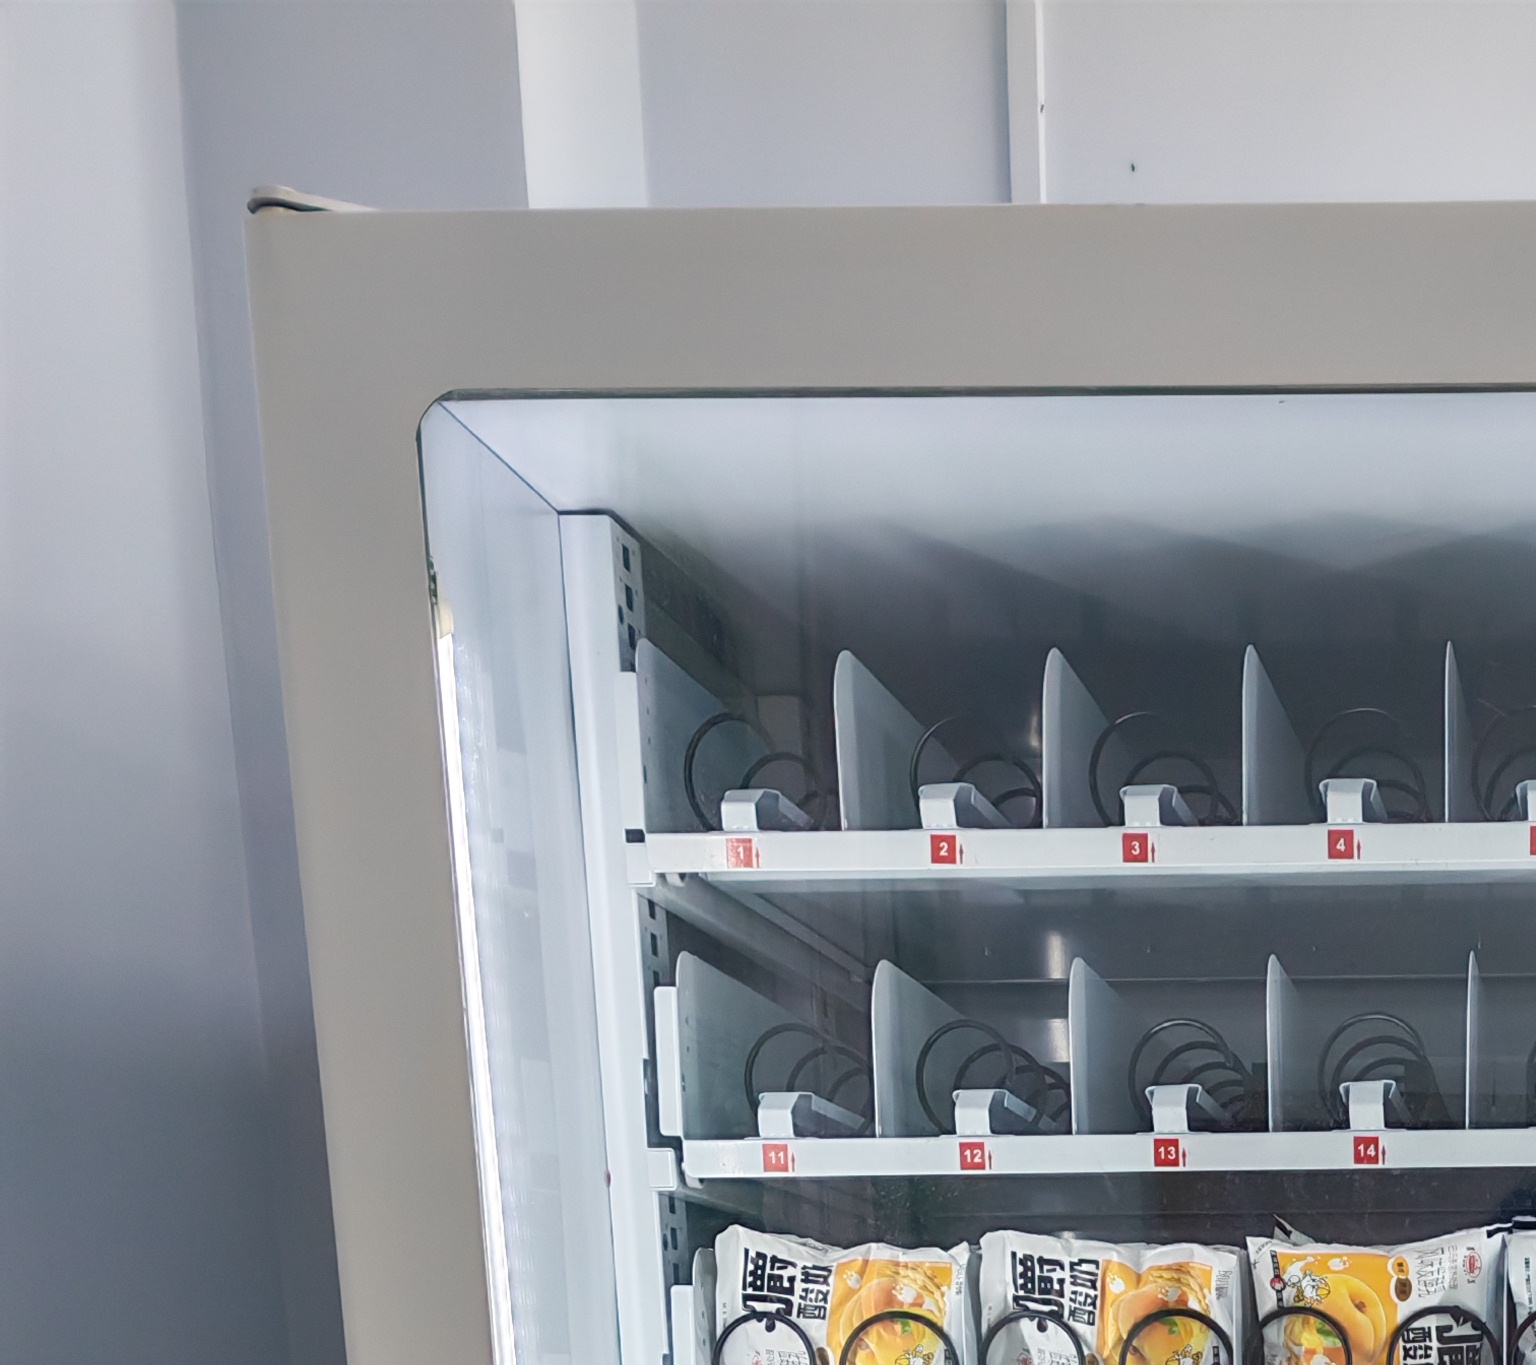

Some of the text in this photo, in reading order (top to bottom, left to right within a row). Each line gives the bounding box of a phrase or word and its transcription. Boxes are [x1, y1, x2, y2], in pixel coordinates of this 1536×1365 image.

[939, 841, 949, 856] 2
[1131, 840, 1141, 855] 3
[1336, 837, 1346, 852] 4
[735, 845, 746, 861] 1
[768, 1150, 785, 1165] 11
[963, 1148, 983, 1163] 12
[1158, 1145, 1176, 1160] 13
[1357, 1143, 1376, 1157] 14
[1067, 1257, 1100, 1327] 酸奶
